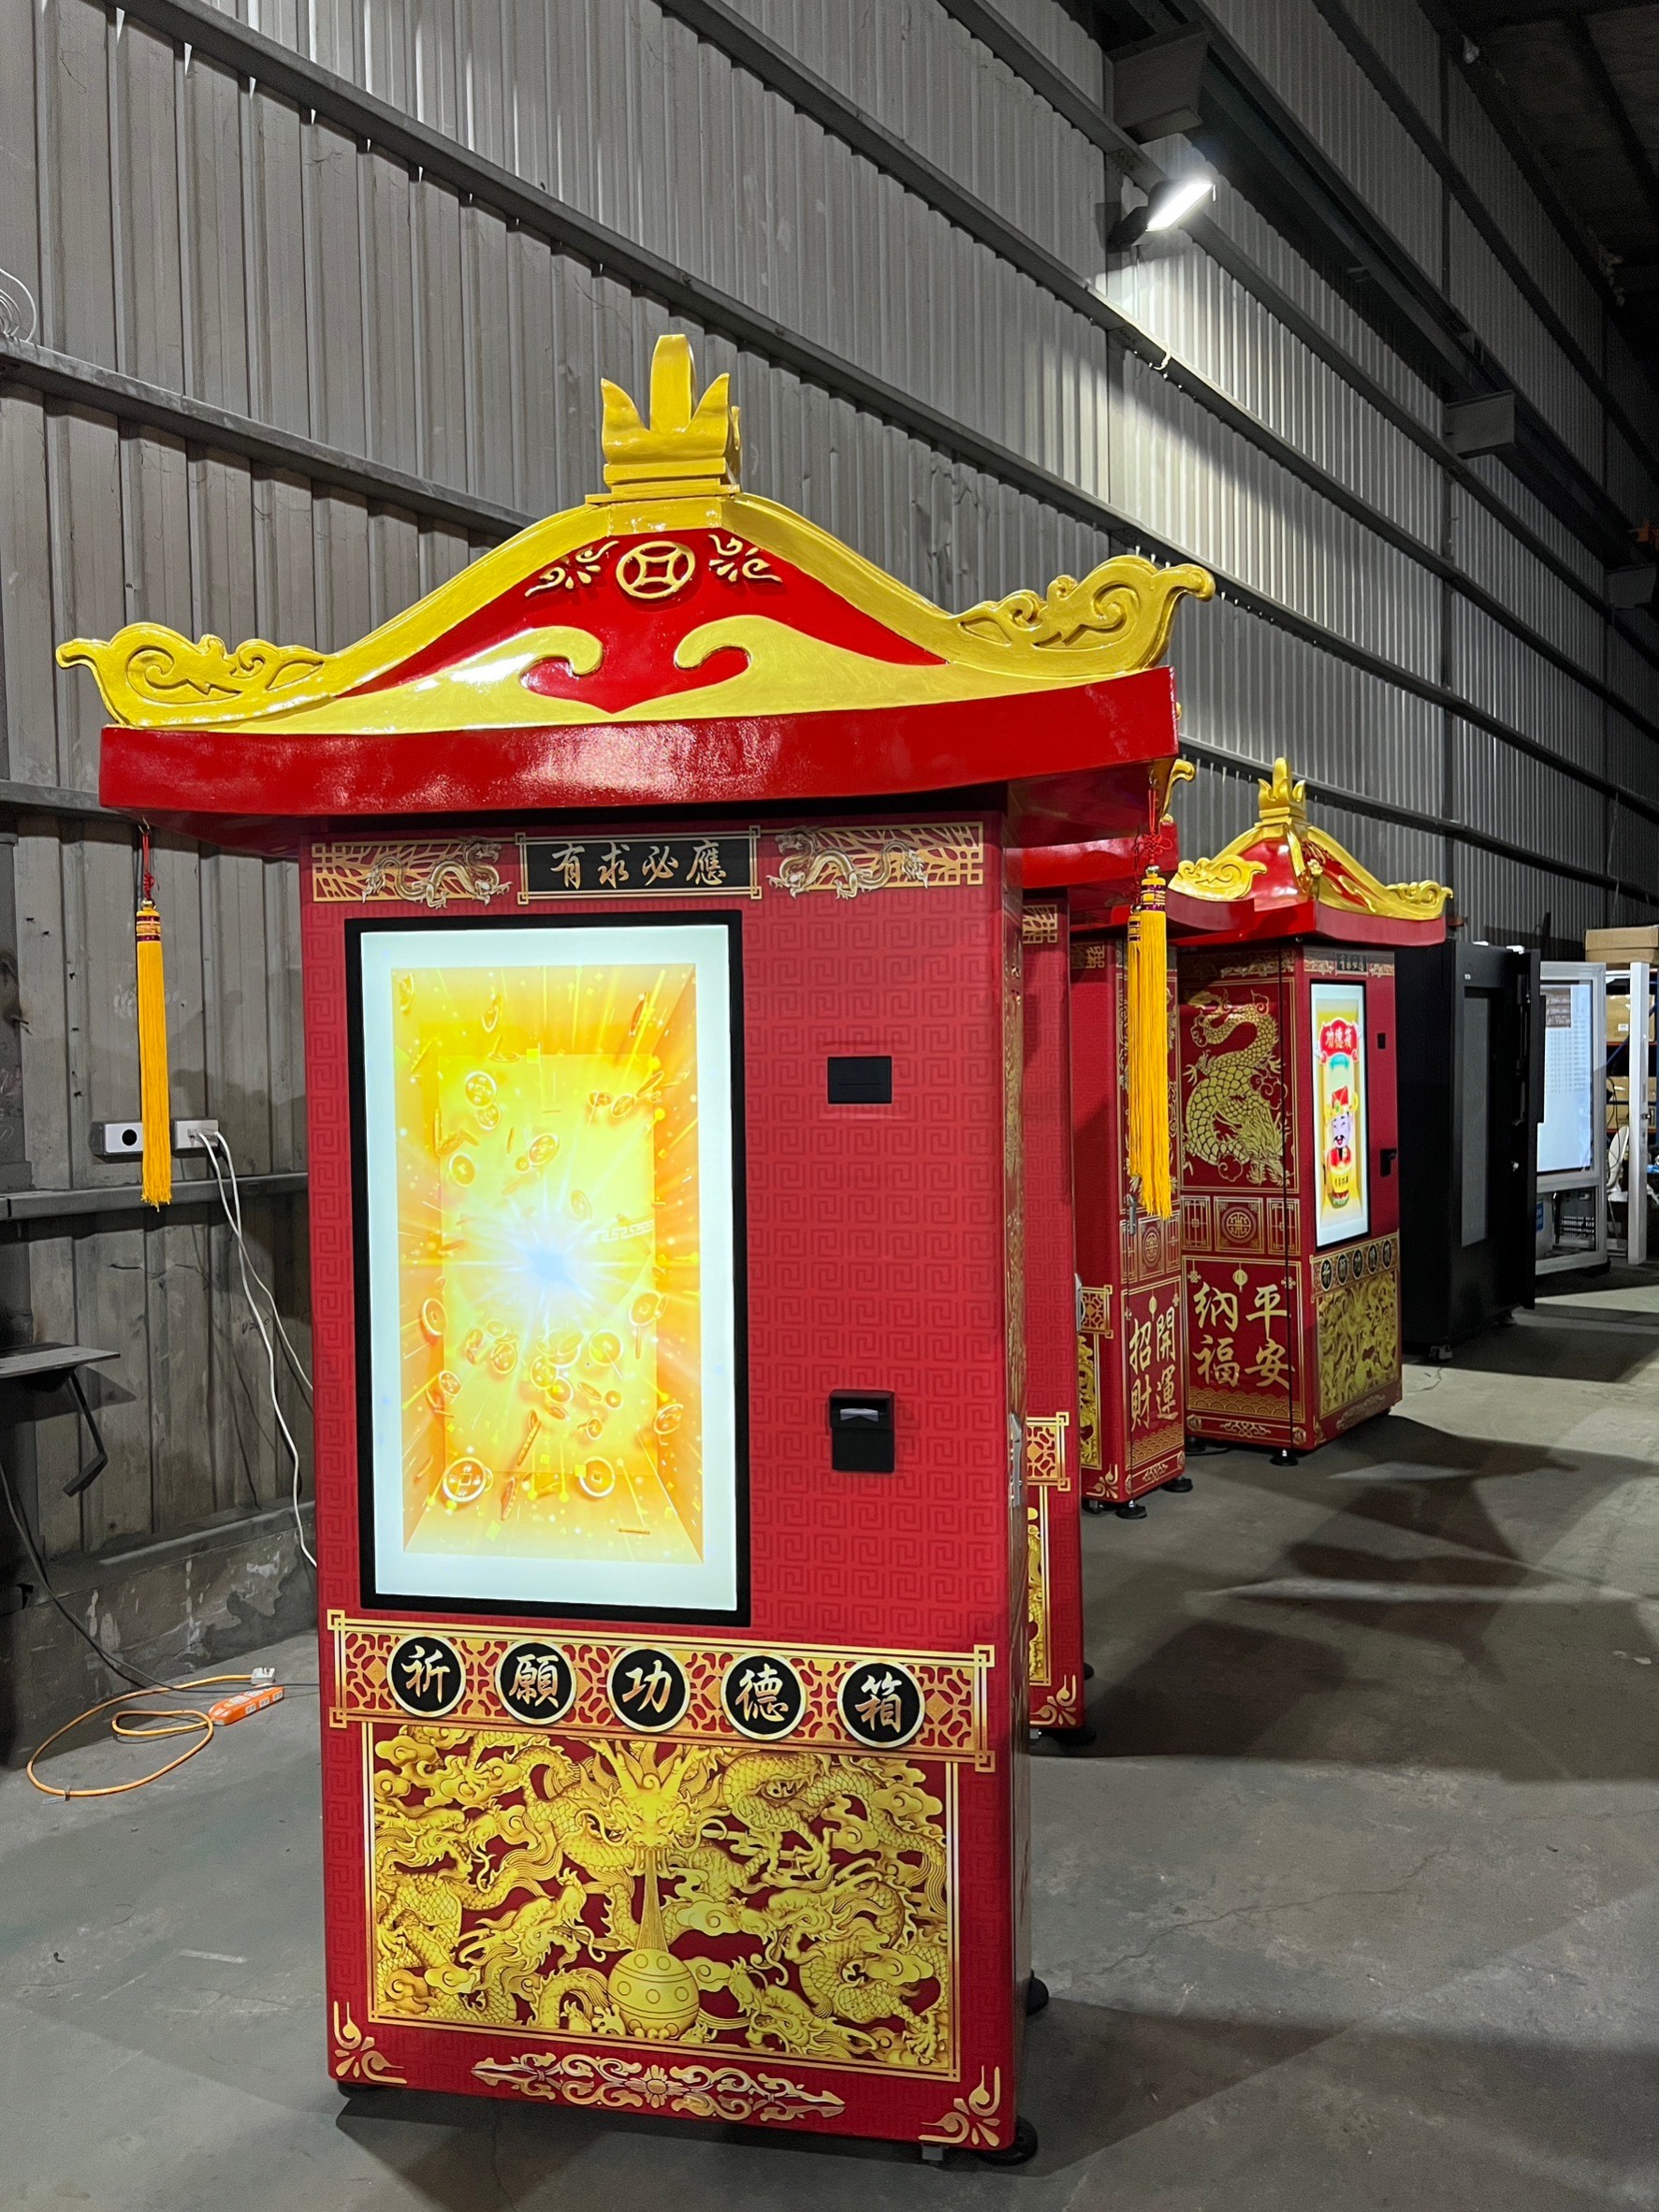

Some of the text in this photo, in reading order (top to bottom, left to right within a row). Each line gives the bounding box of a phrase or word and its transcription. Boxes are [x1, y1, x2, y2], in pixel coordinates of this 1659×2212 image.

[549, 840, 727, 890] 有求必應
[1128, 1317, 1153, 1433] 招財
[1156, 1306, 1180, 1420] 開運
[1192, 1280, 1241, 1388] 納福
[1244, 1283, 1296, 1391] 平安
[400, 1645, 909, 1736] 祈願功德箱
